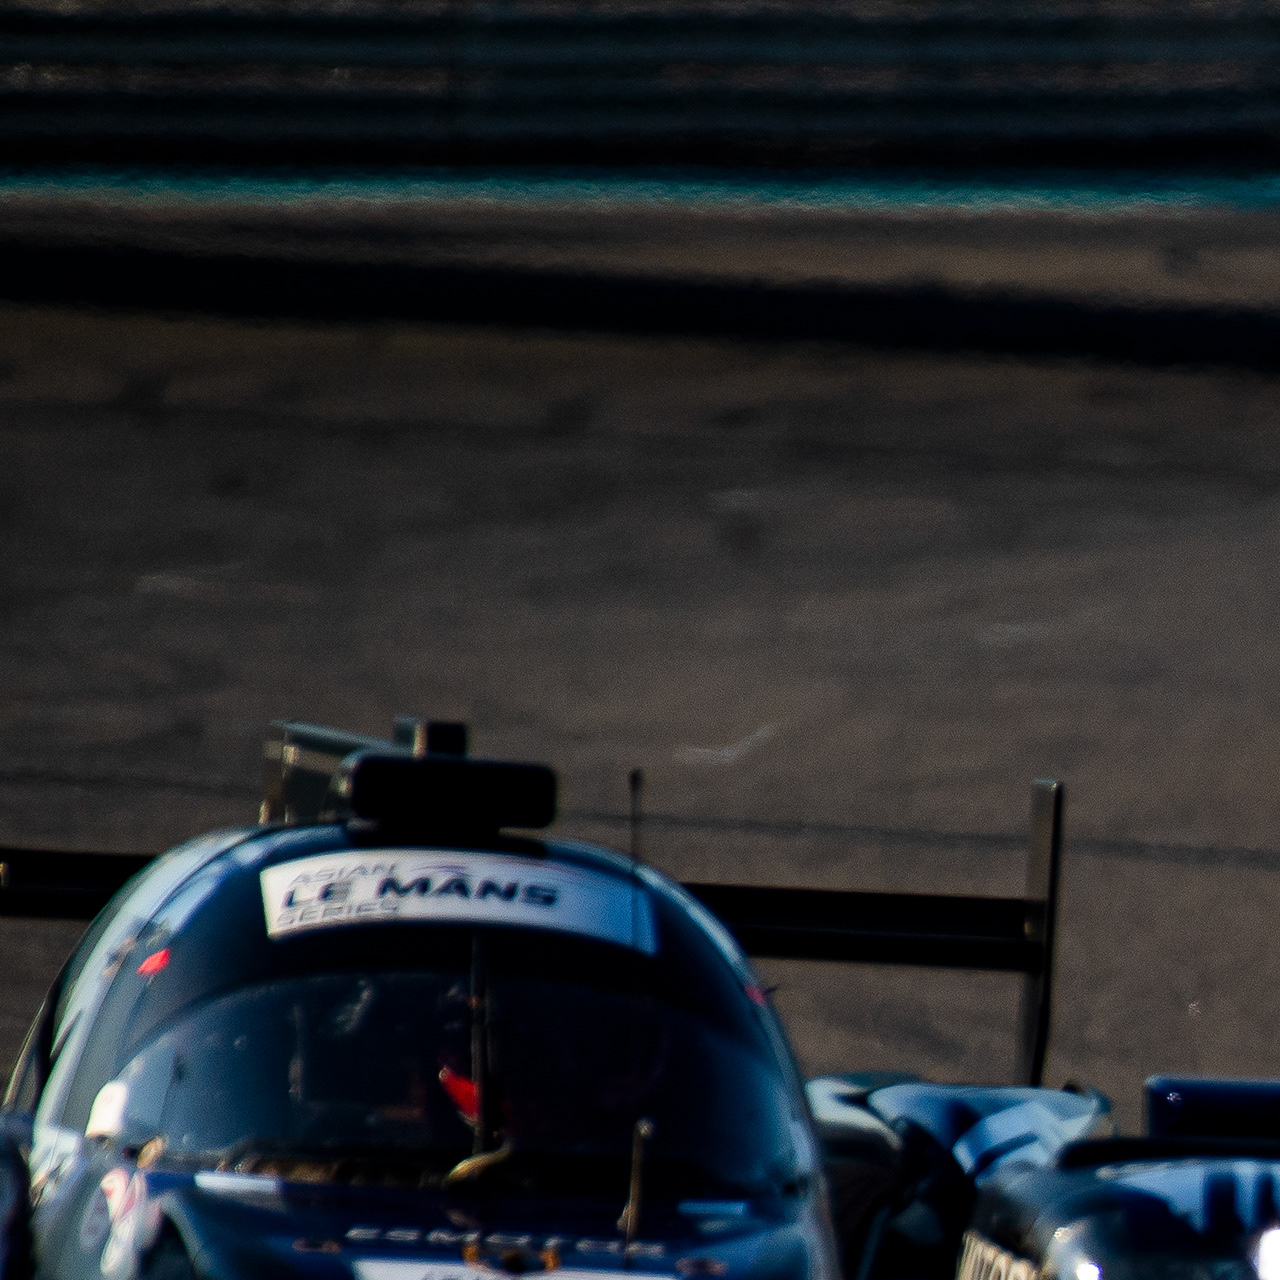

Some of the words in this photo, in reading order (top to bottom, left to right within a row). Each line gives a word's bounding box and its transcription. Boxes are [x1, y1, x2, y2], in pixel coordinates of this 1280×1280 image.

[289, 863, 397, 886] ASIAN
[284, 881, 353, 908] LE
[378, 876, 557, 906] MANS
[277, 900, 399, 927] SERIES
